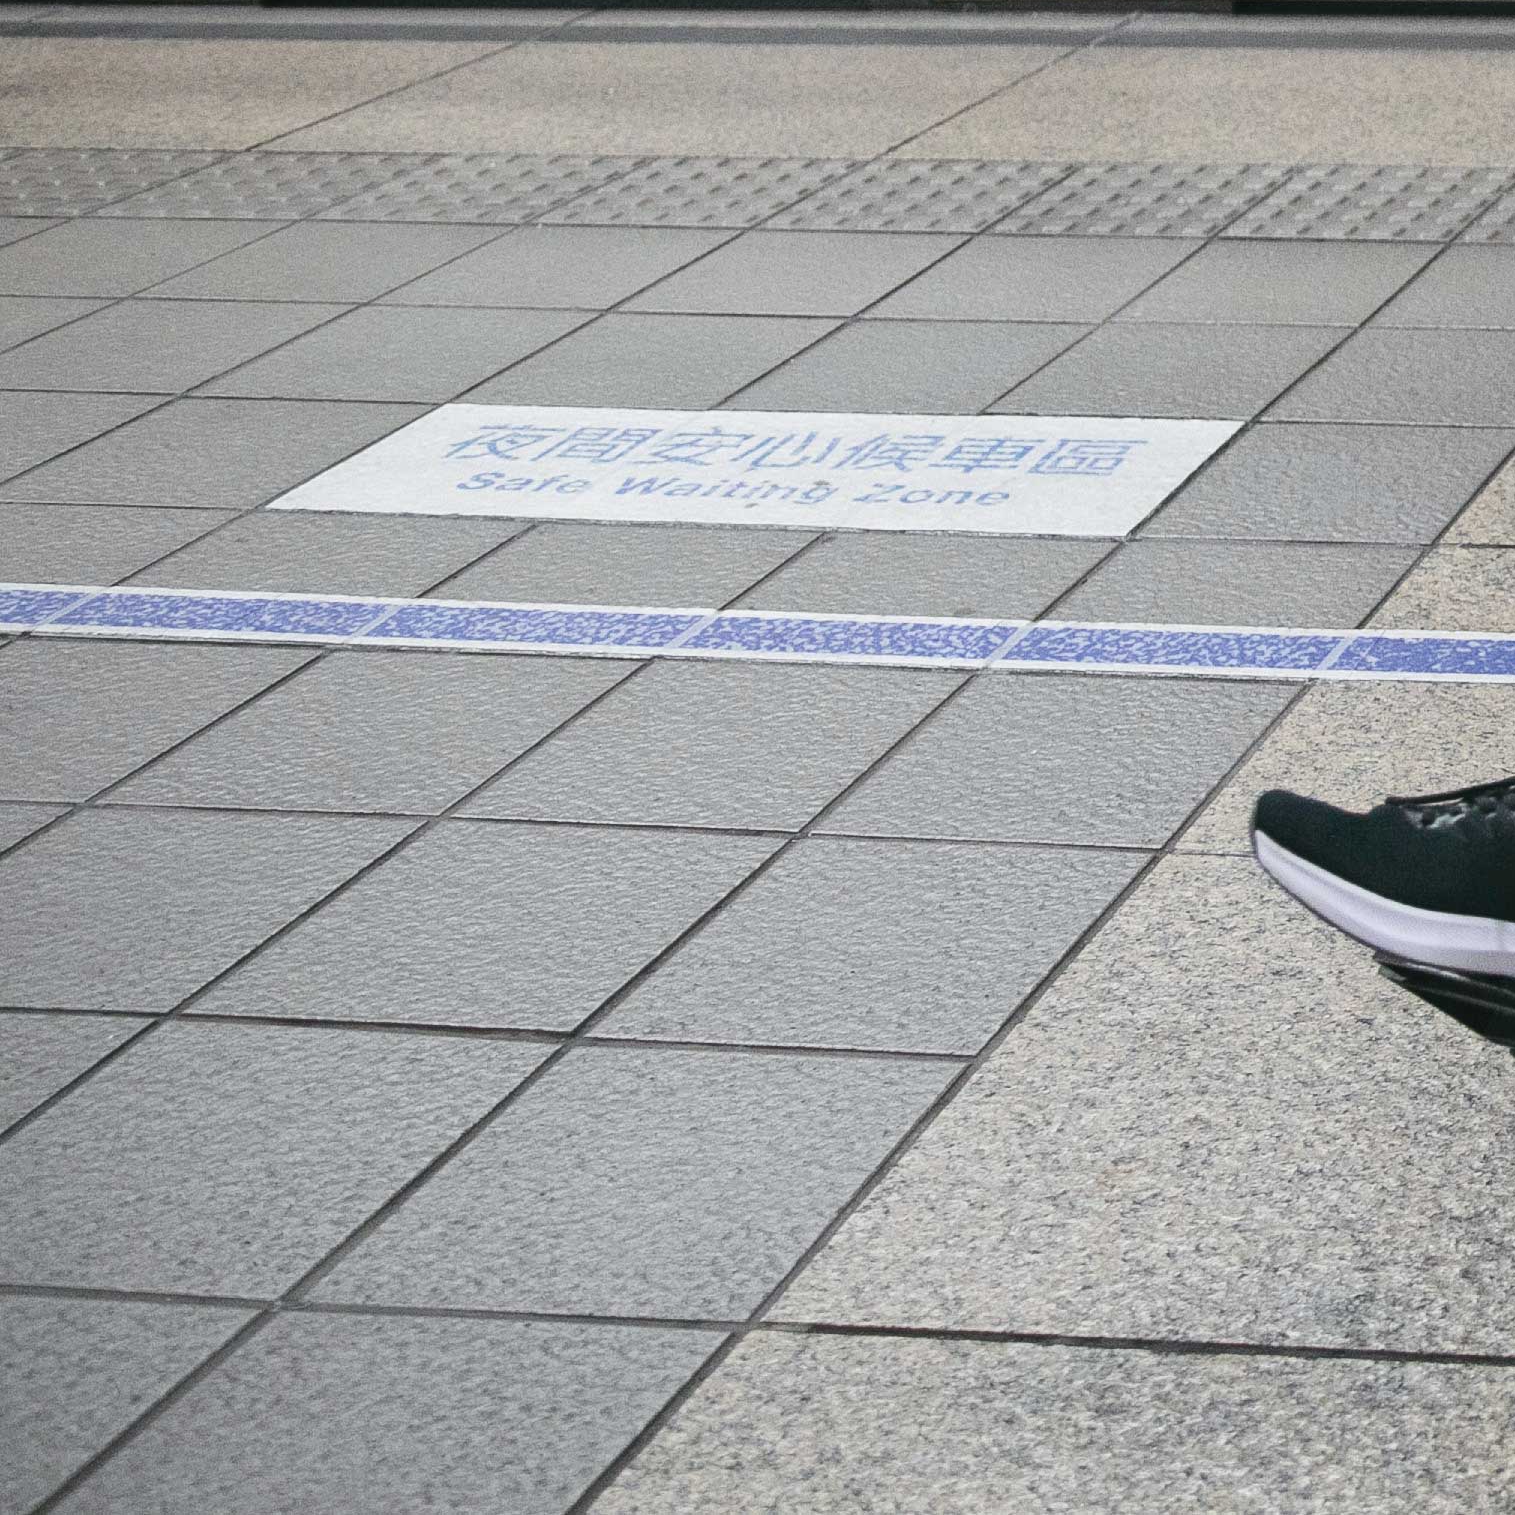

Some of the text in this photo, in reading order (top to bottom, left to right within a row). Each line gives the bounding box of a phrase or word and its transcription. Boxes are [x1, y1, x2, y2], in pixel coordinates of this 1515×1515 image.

[444, 424, 1148, 476] 夜間安心候車區
[455, 470, 1011, 507] Safe Waiting Zone
